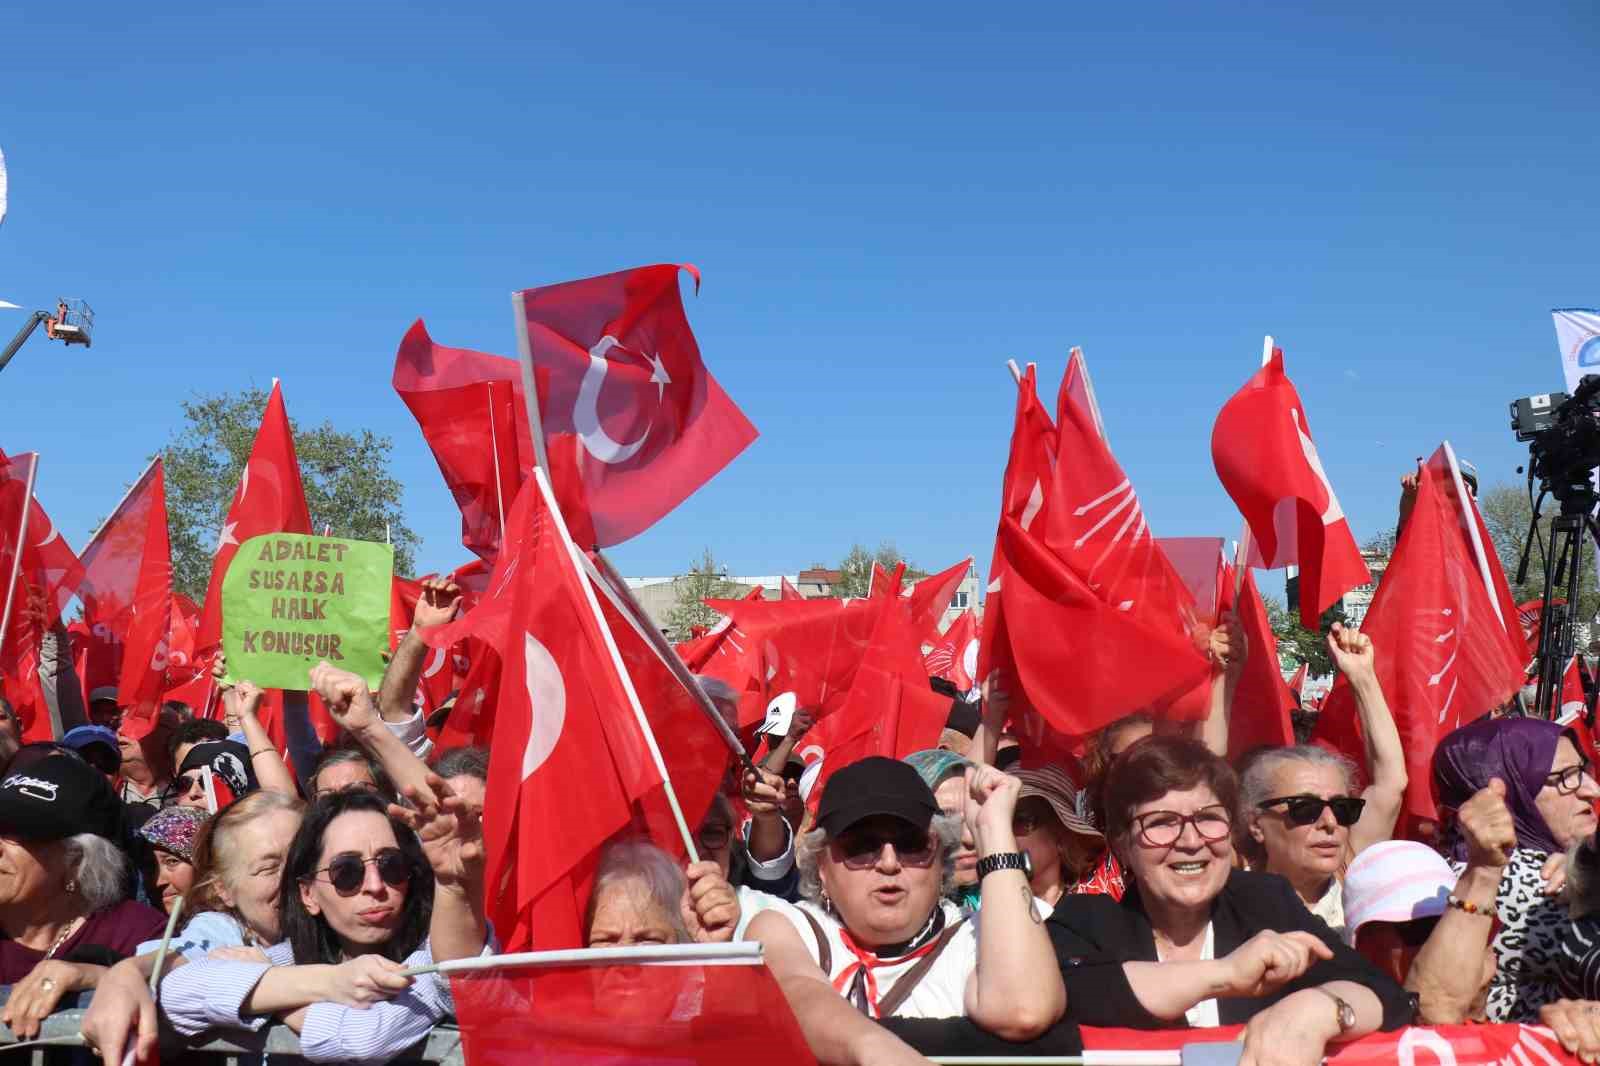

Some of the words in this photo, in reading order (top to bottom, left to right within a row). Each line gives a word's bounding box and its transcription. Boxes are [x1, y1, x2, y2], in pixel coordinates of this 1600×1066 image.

[258, 540, 349, 562] ADALET
[249, 570, 345, 595] SUSARSA
[271, 597, 328, 620] HALK
